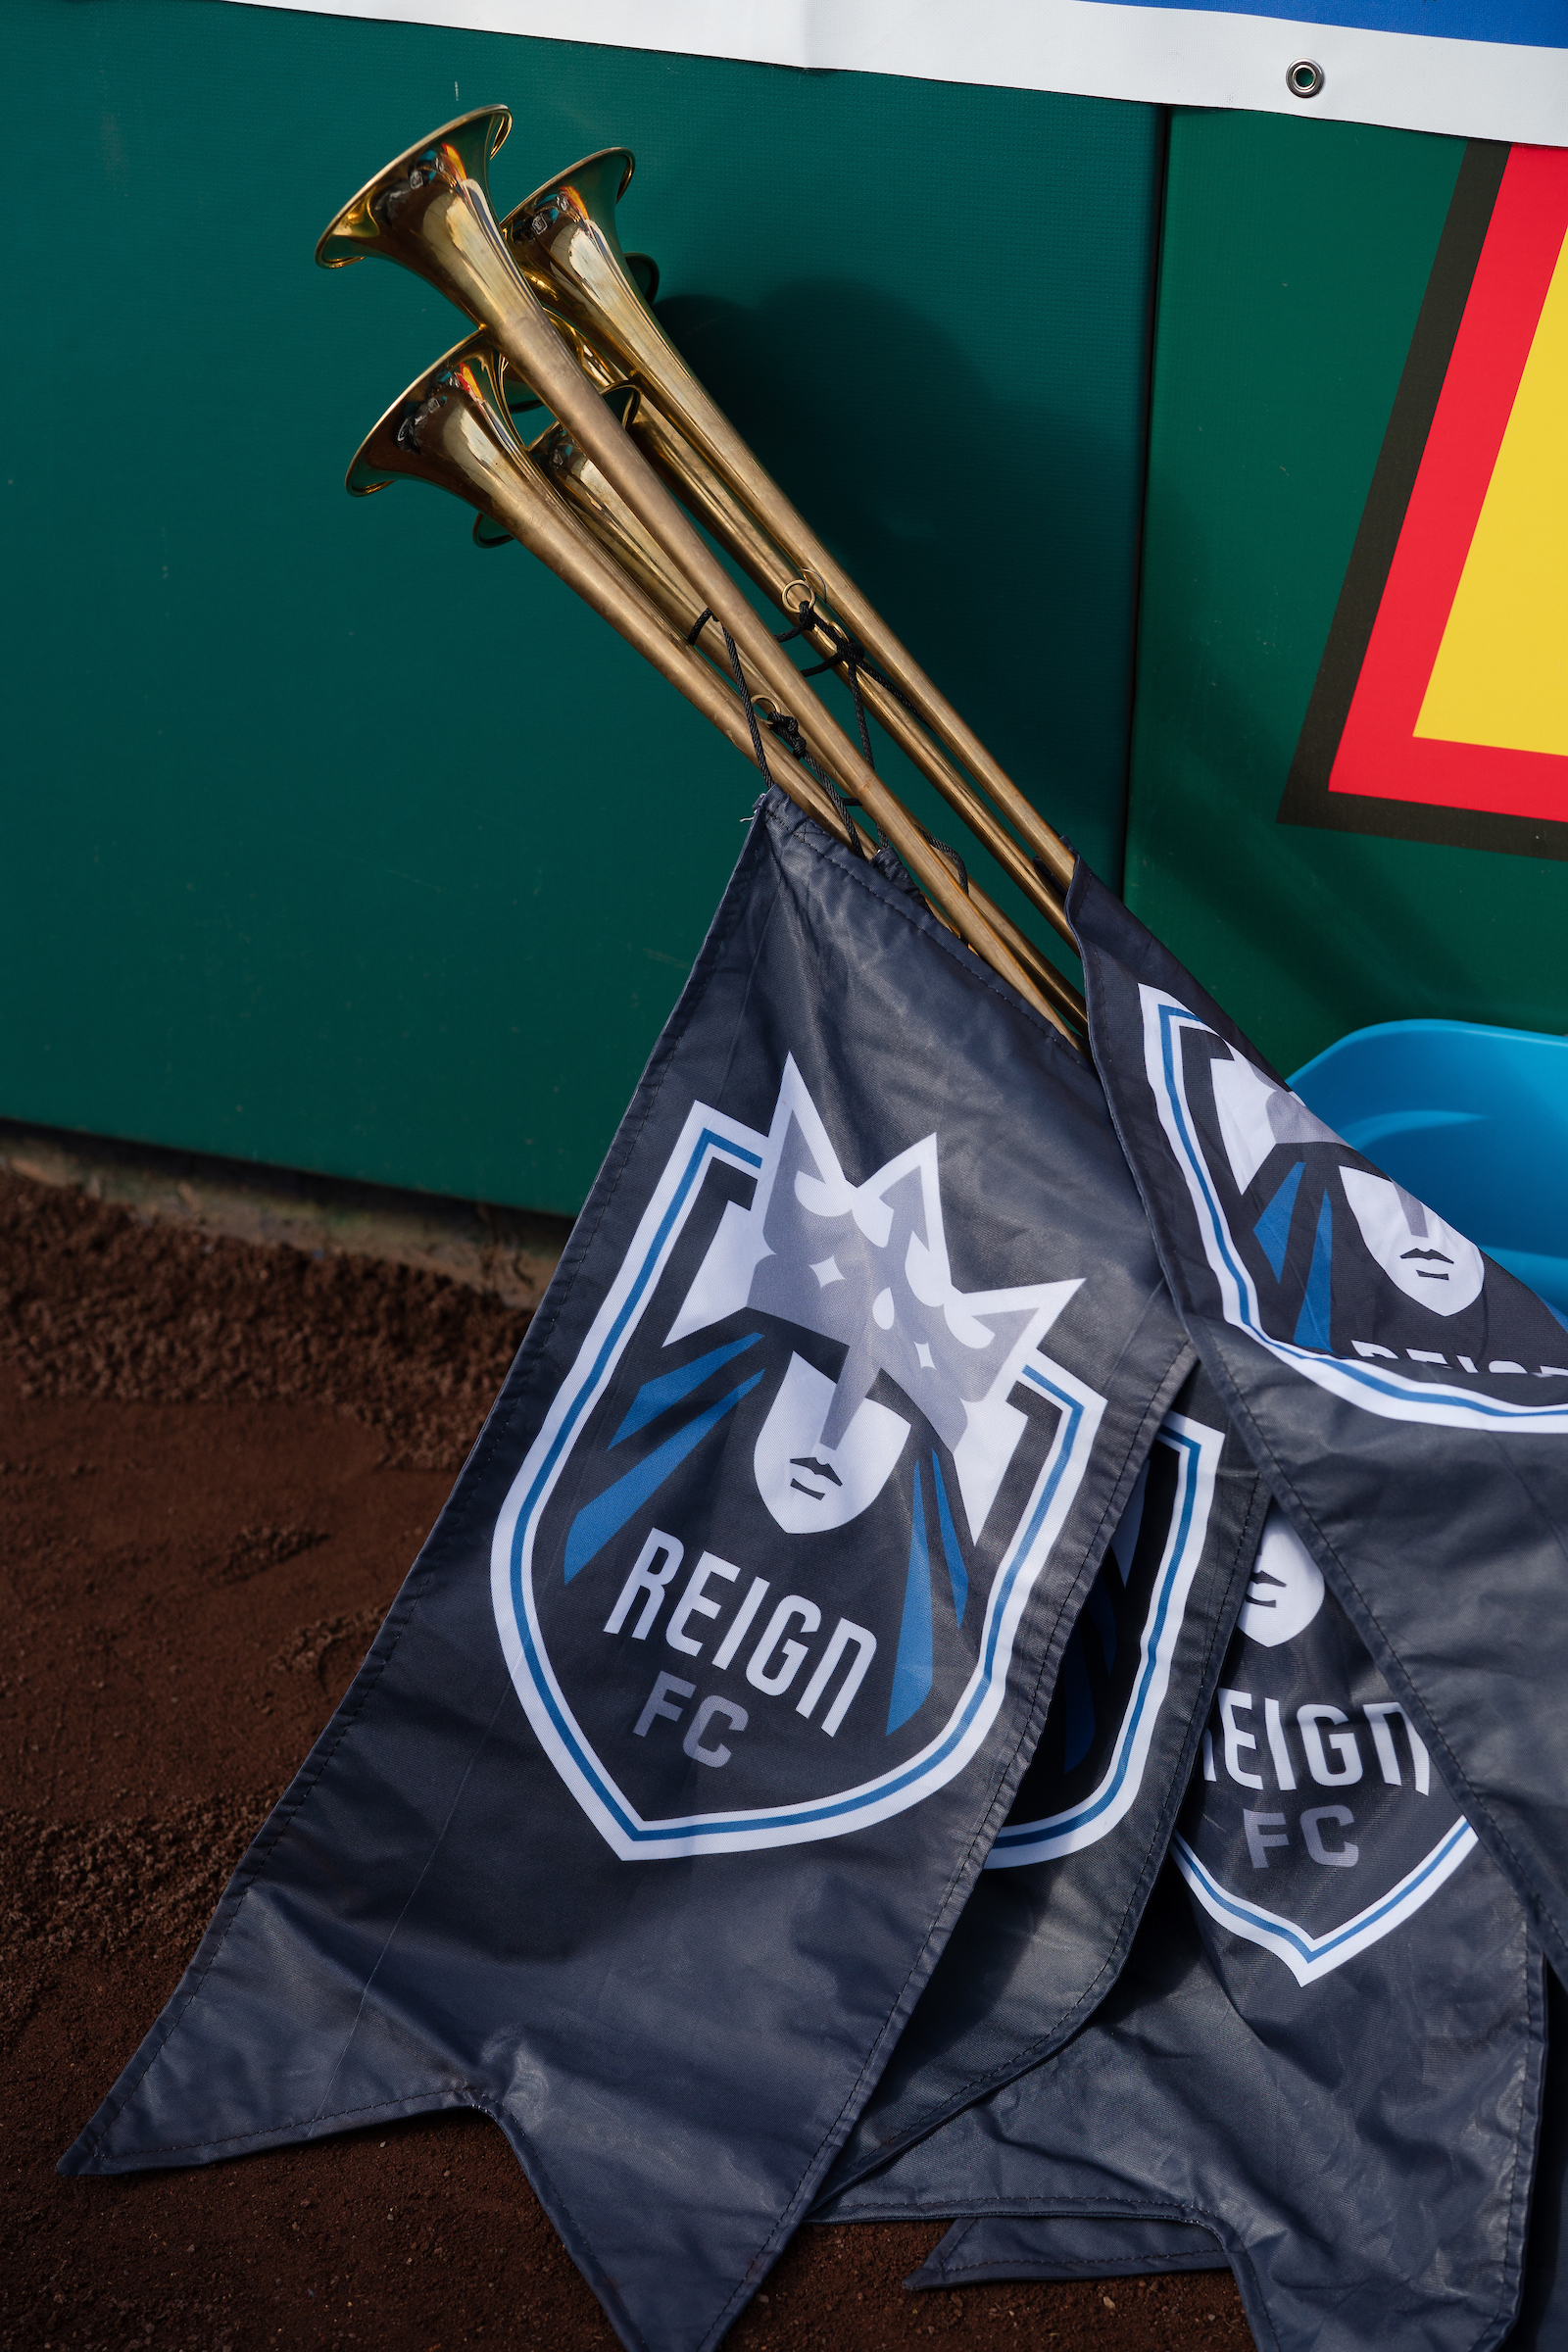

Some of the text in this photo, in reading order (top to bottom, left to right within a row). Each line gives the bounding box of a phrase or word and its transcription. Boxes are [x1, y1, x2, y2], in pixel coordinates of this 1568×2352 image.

[603, 1527, 877, 1738] REIGN
[633, 1670, 749, 1768] FC
[1202, 1687, 1430, 1796] EIGN
[1243, 1804, 1359, 1869] FC
